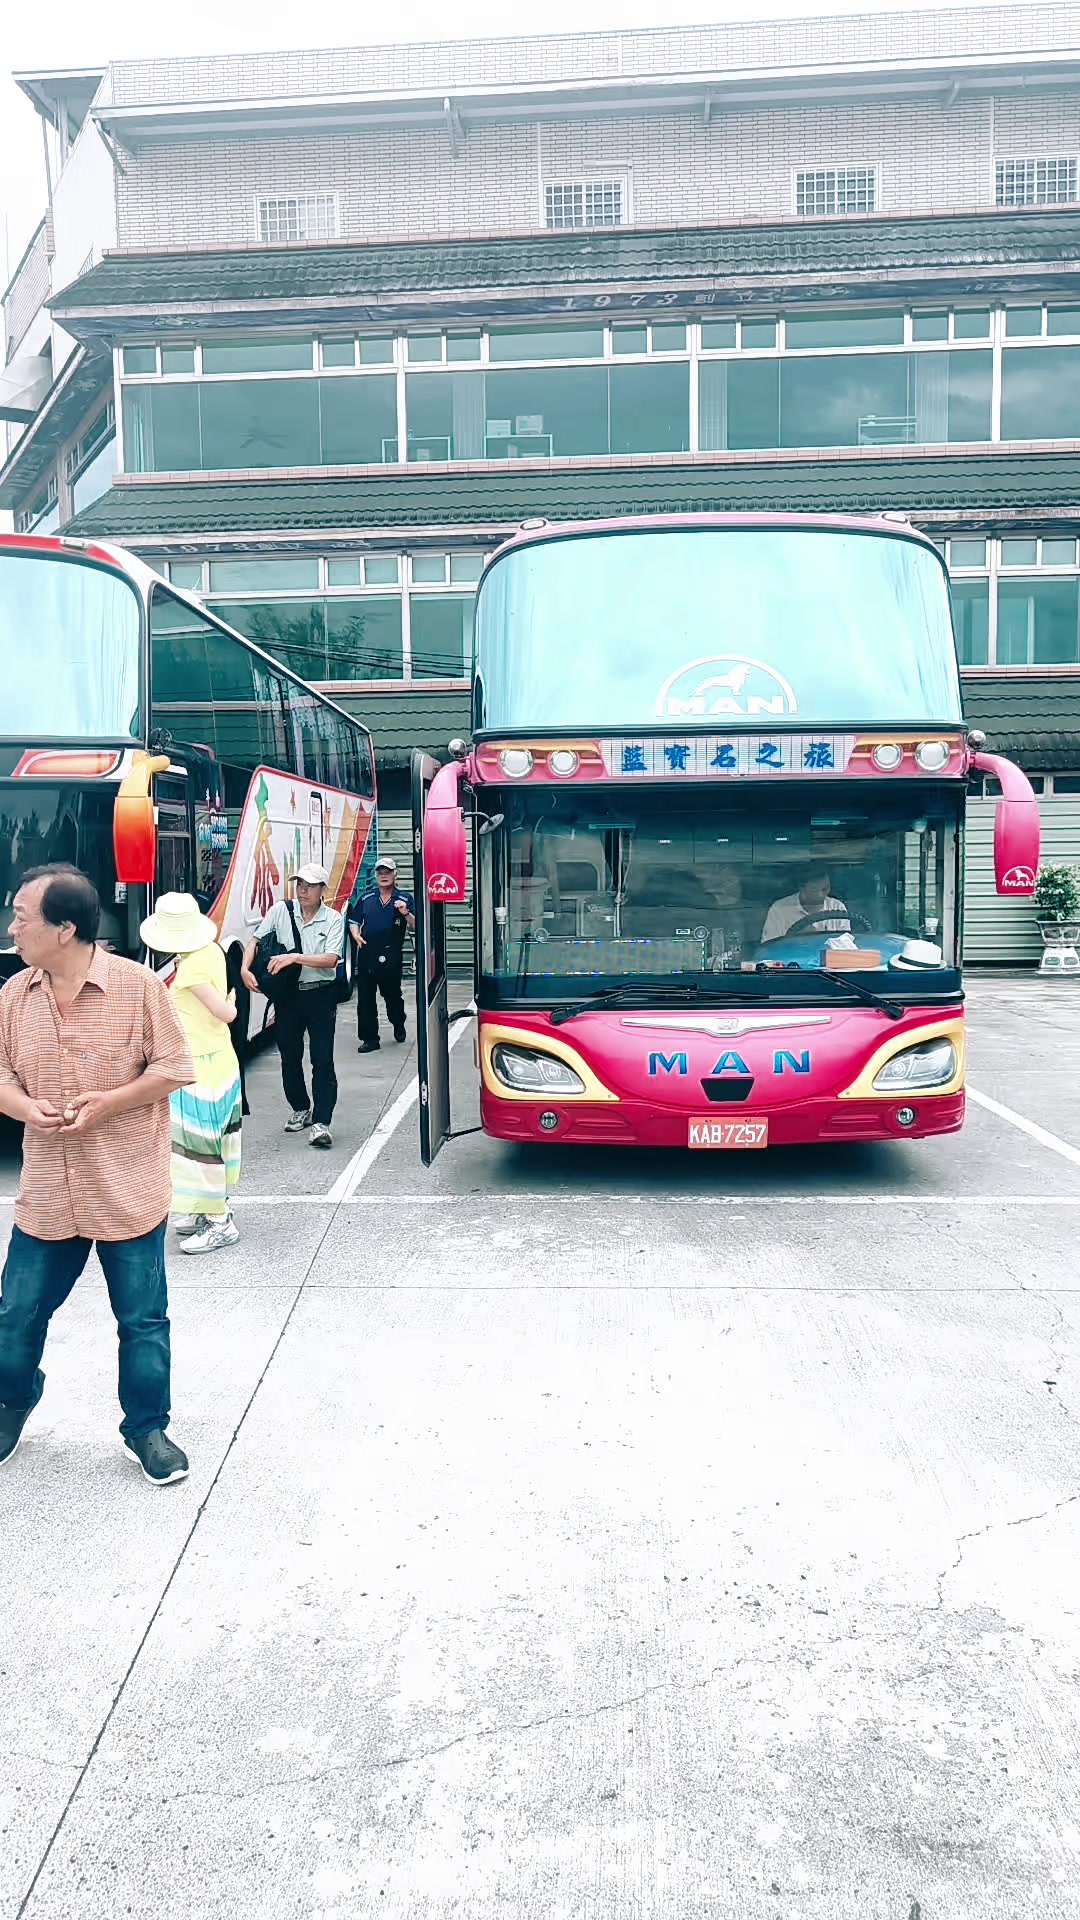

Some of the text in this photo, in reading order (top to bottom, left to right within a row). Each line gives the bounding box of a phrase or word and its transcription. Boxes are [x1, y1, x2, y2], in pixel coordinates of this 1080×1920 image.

[668, 695, 785, 716] MAN
[621, 742, 835, 772] 藍寶石之旅
[1004, 879, 1034, 887] MAN
[648, 1049, 811, 1075] MAN
